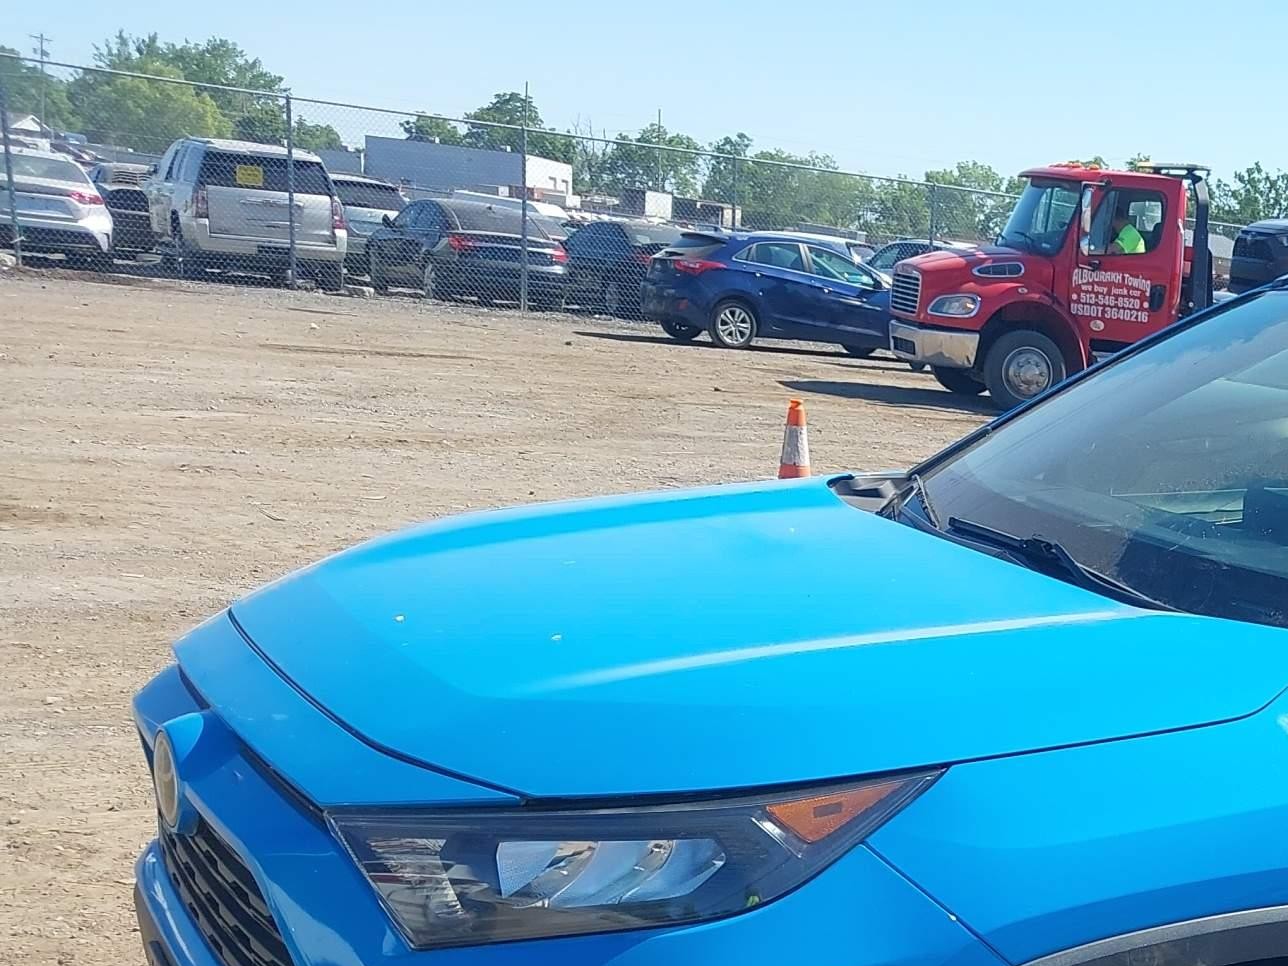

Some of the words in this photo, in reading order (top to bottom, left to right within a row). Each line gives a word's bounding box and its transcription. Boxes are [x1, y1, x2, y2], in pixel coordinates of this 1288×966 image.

[1123, 273, 1151, 297] Towing
[1080, 293, 1140, 309] 513-546-8520
[1070, 303, 1104, 317] USDOT
[1104, 307, 1149, 323] 3640216
